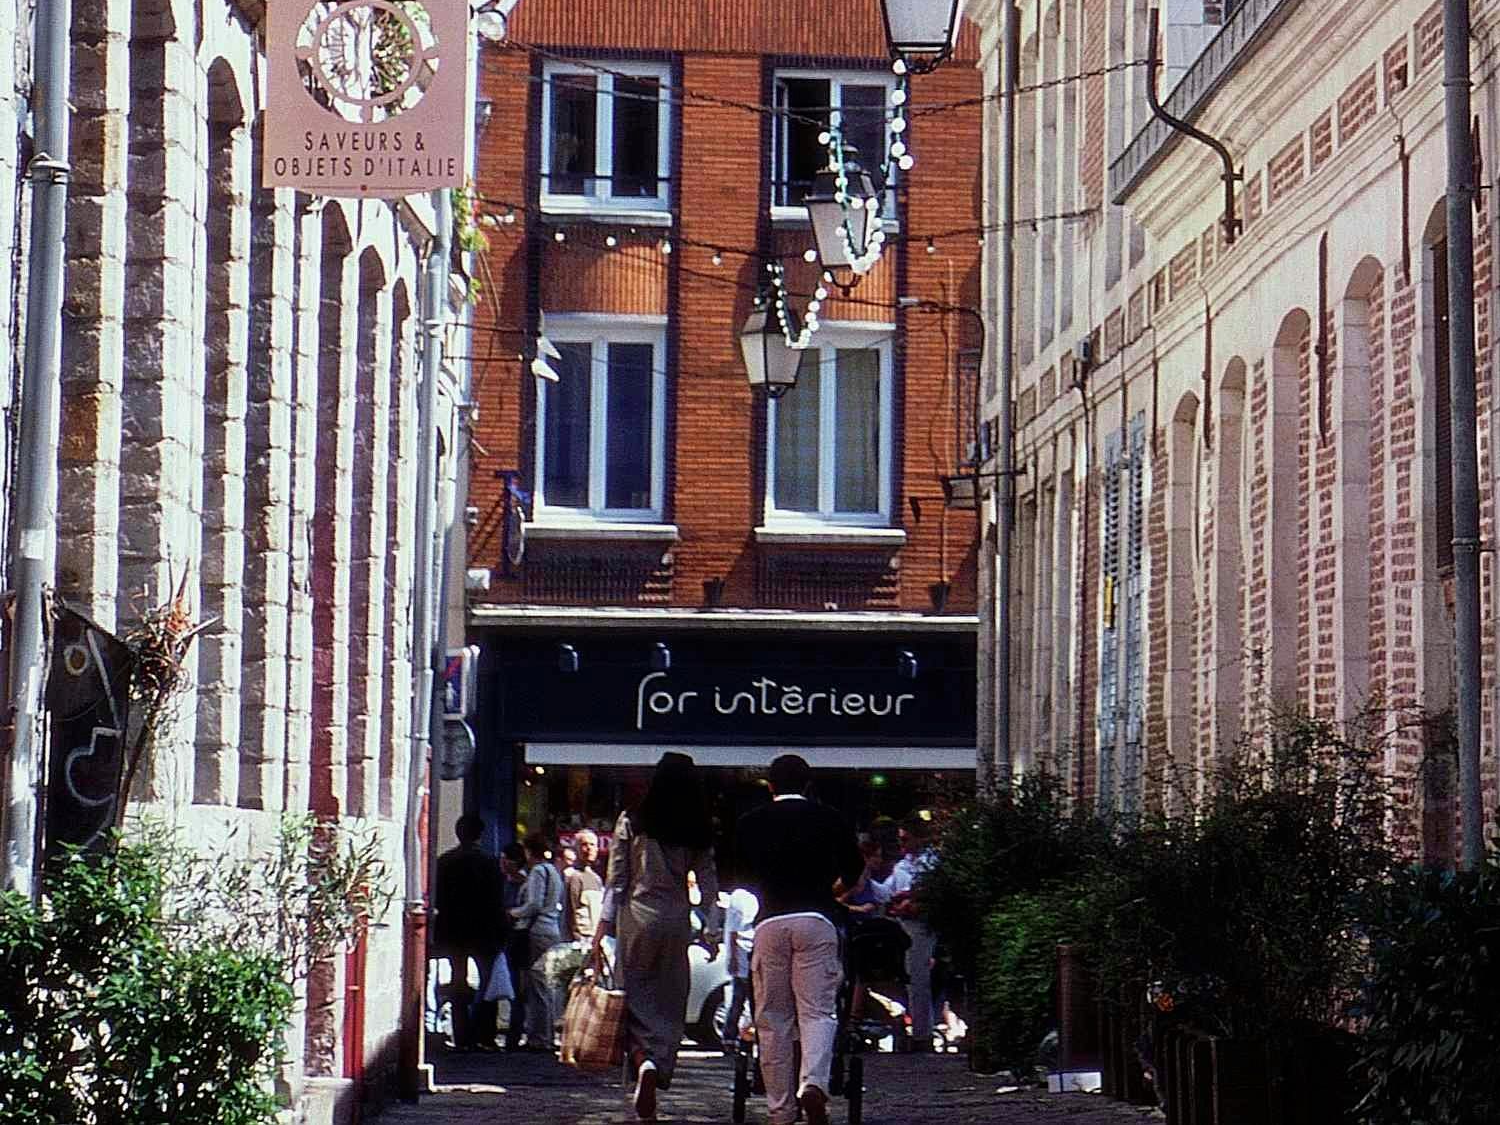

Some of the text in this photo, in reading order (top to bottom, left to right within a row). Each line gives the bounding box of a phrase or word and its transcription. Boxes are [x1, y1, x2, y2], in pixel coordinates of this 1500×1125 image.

[304, 131, 425, 151] SAVEURS &
[274, 157, 456, 177] OBJETS D'ITALIE
[637, 672, 697, 729] for
